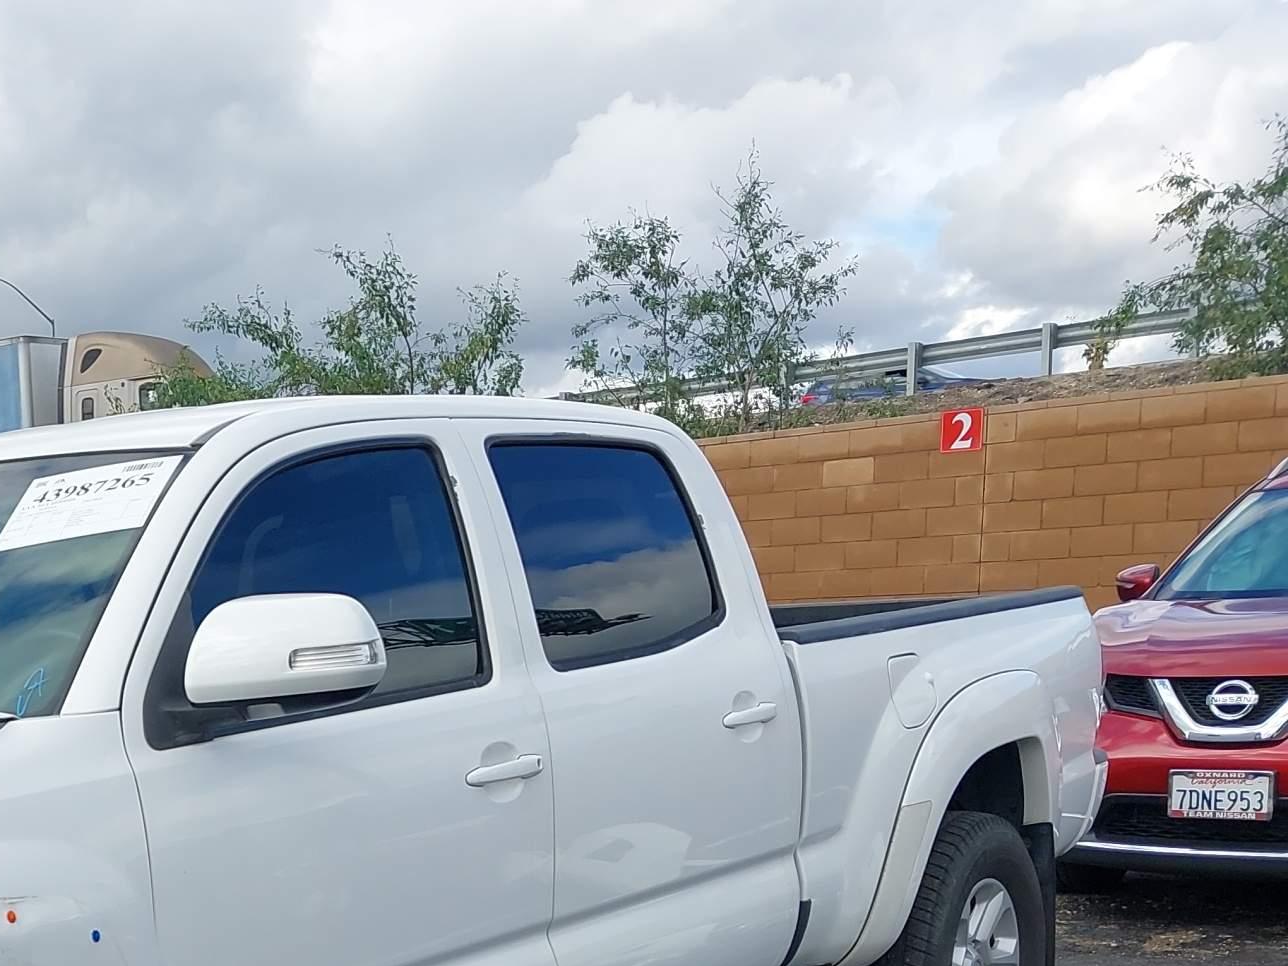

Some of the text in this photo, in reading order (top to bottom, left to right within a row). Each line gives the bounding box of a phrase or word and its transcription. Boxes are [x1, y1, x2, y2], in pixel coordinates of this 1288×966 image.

[949, 412, 973, 449] 2
[33, 472, 154, 504] 43987265
[1210, 695, 1252, 703] NISSAN
[1191, 779, 1253, 788] California
[1175, 789, 1264, 812] 7DNE953
